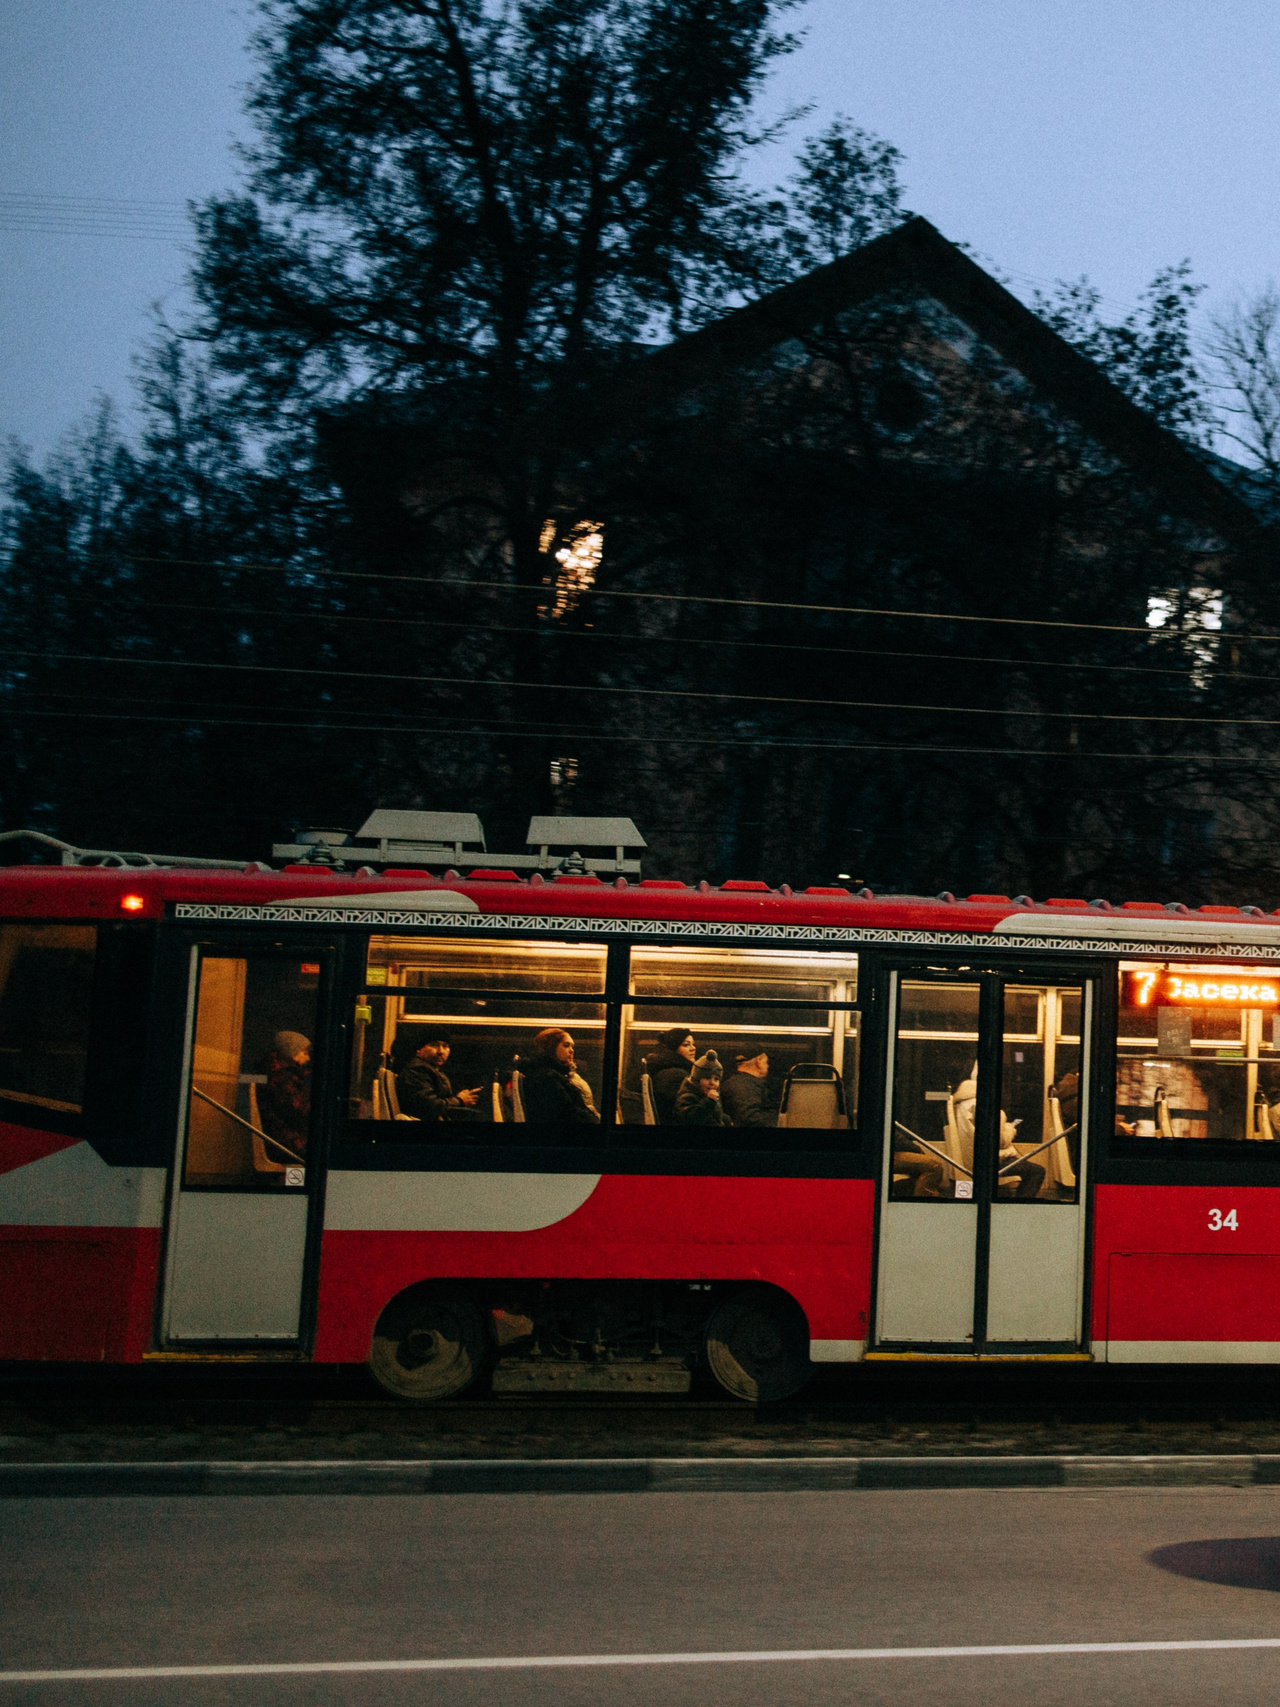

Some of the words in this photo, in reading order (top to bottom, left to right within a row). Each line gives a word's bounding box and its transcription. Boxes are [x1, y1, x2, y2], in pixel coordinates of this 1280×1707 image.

[1134, 972, 1157, 1004] 7
[1169, 977, 1278, 1001] Засека
[1207, 1208, 1239, 1231] 34
